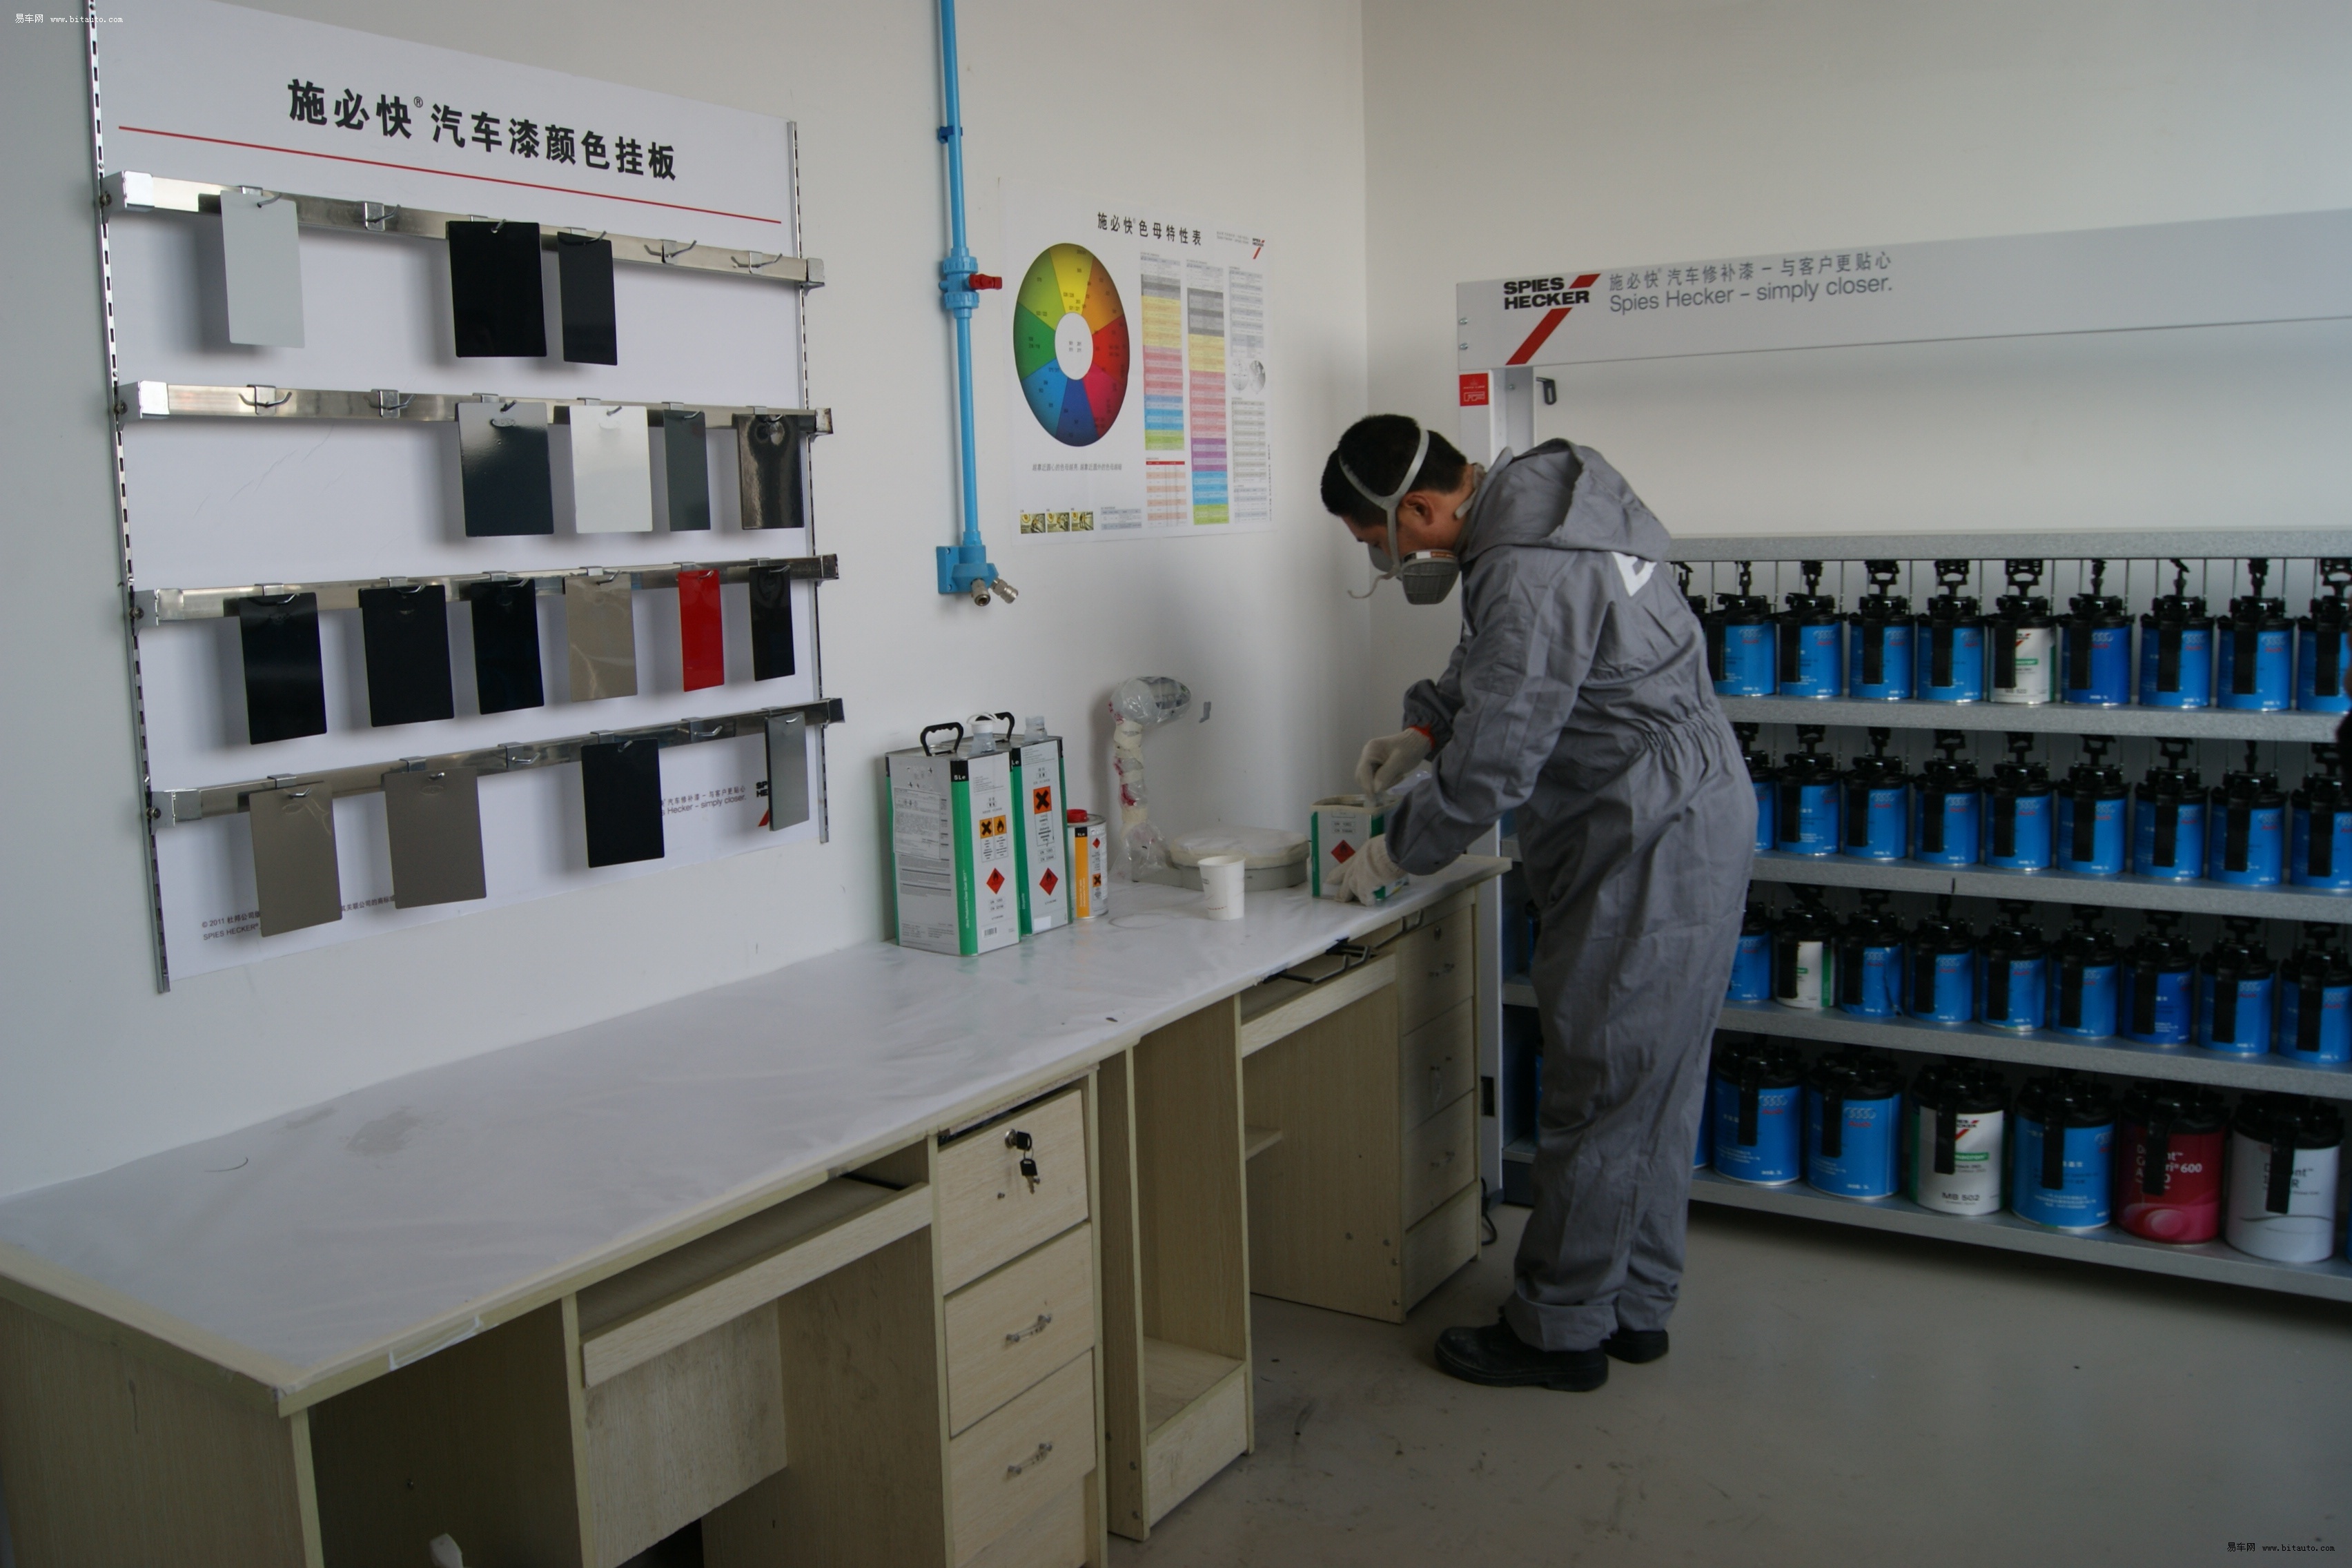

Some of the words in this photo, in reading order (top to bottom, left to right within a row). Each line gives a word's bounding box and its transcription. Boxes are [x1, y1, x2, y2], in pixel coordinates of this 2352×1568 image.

[1780, 251, 1892, 277] 与客户更贴心
[1503, 277, 1565, 295] SPIES
[1609, 293, 1659, 315] Spies
[1666, 288, 1734, 308] Hecker
[1756, 279, 1819, 302] simply
[1825, 275, 1893, 296] closer.
[1504, 290, 1590, 310] HECKER
[667, 804, 694, 815] Hecker
[700, 798, 723, 809] simply
[724, 793, 747, 804] closer.
[209, 917, 225, 927] 2011
[203, 930, 225, 941] SPIES
[2179, 1163, 2204, 1173] 600
